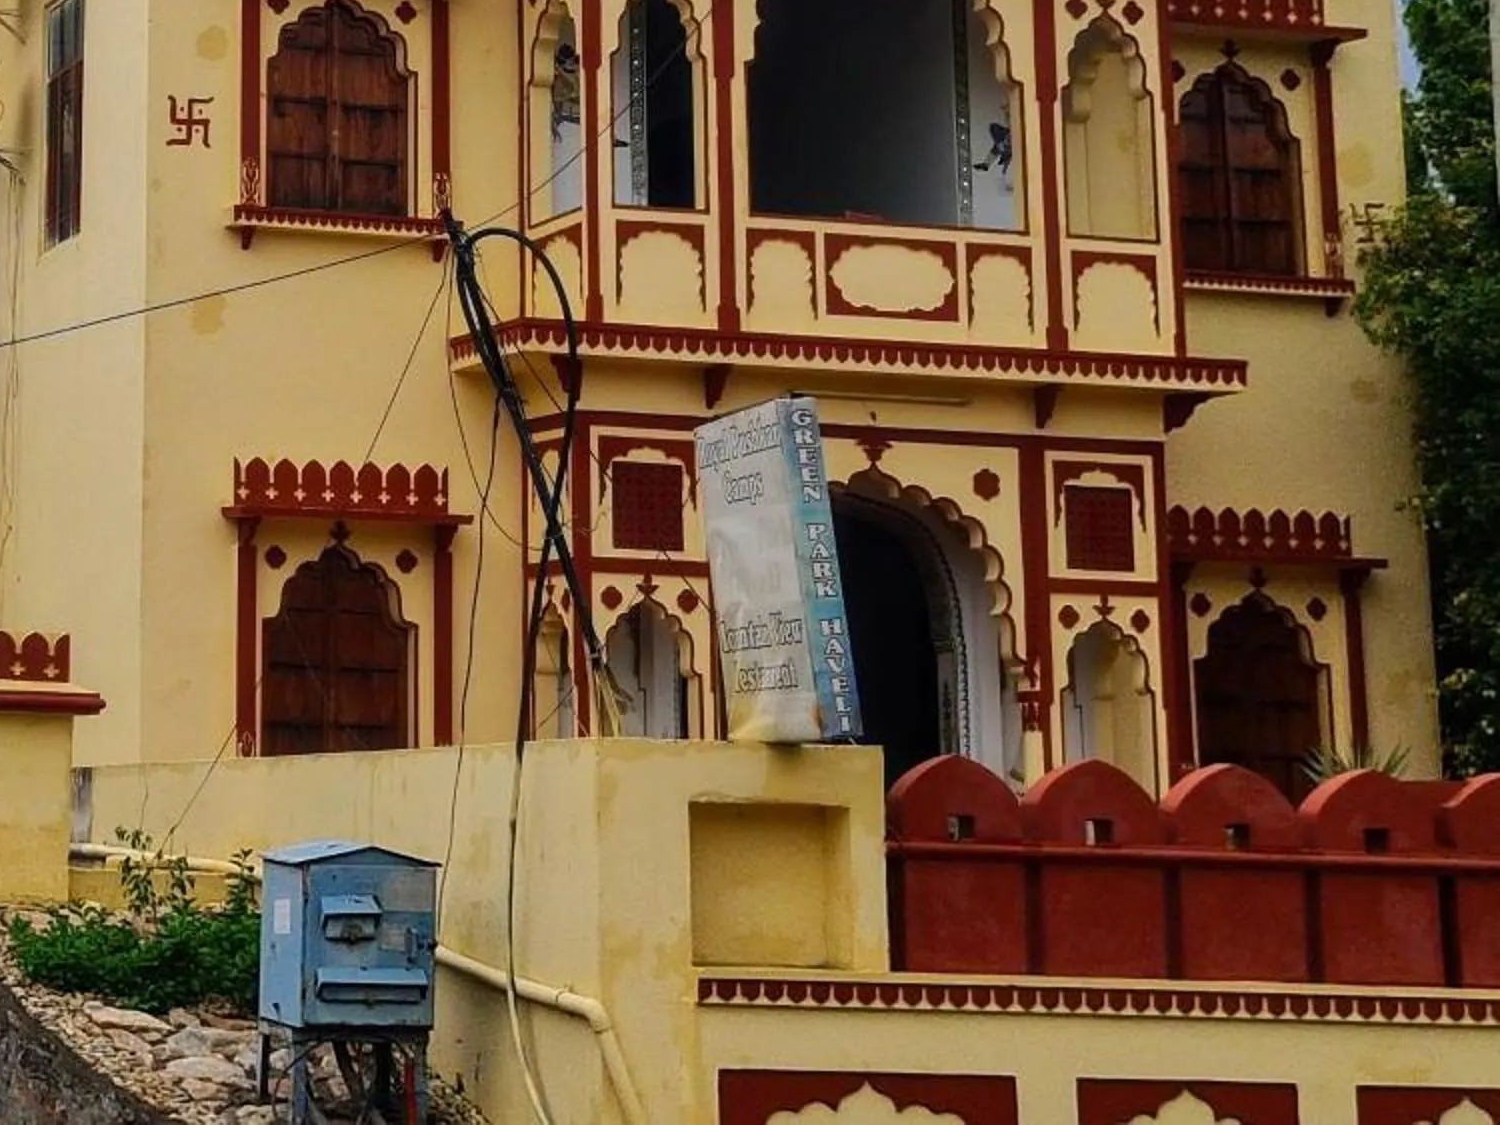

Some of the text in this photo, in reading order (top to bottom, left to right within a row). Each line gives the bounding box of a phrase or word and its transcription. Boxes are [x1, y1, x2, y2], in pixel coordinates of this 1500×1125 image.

[791, 410, 852, 733] GREEN PARK HAVELI
